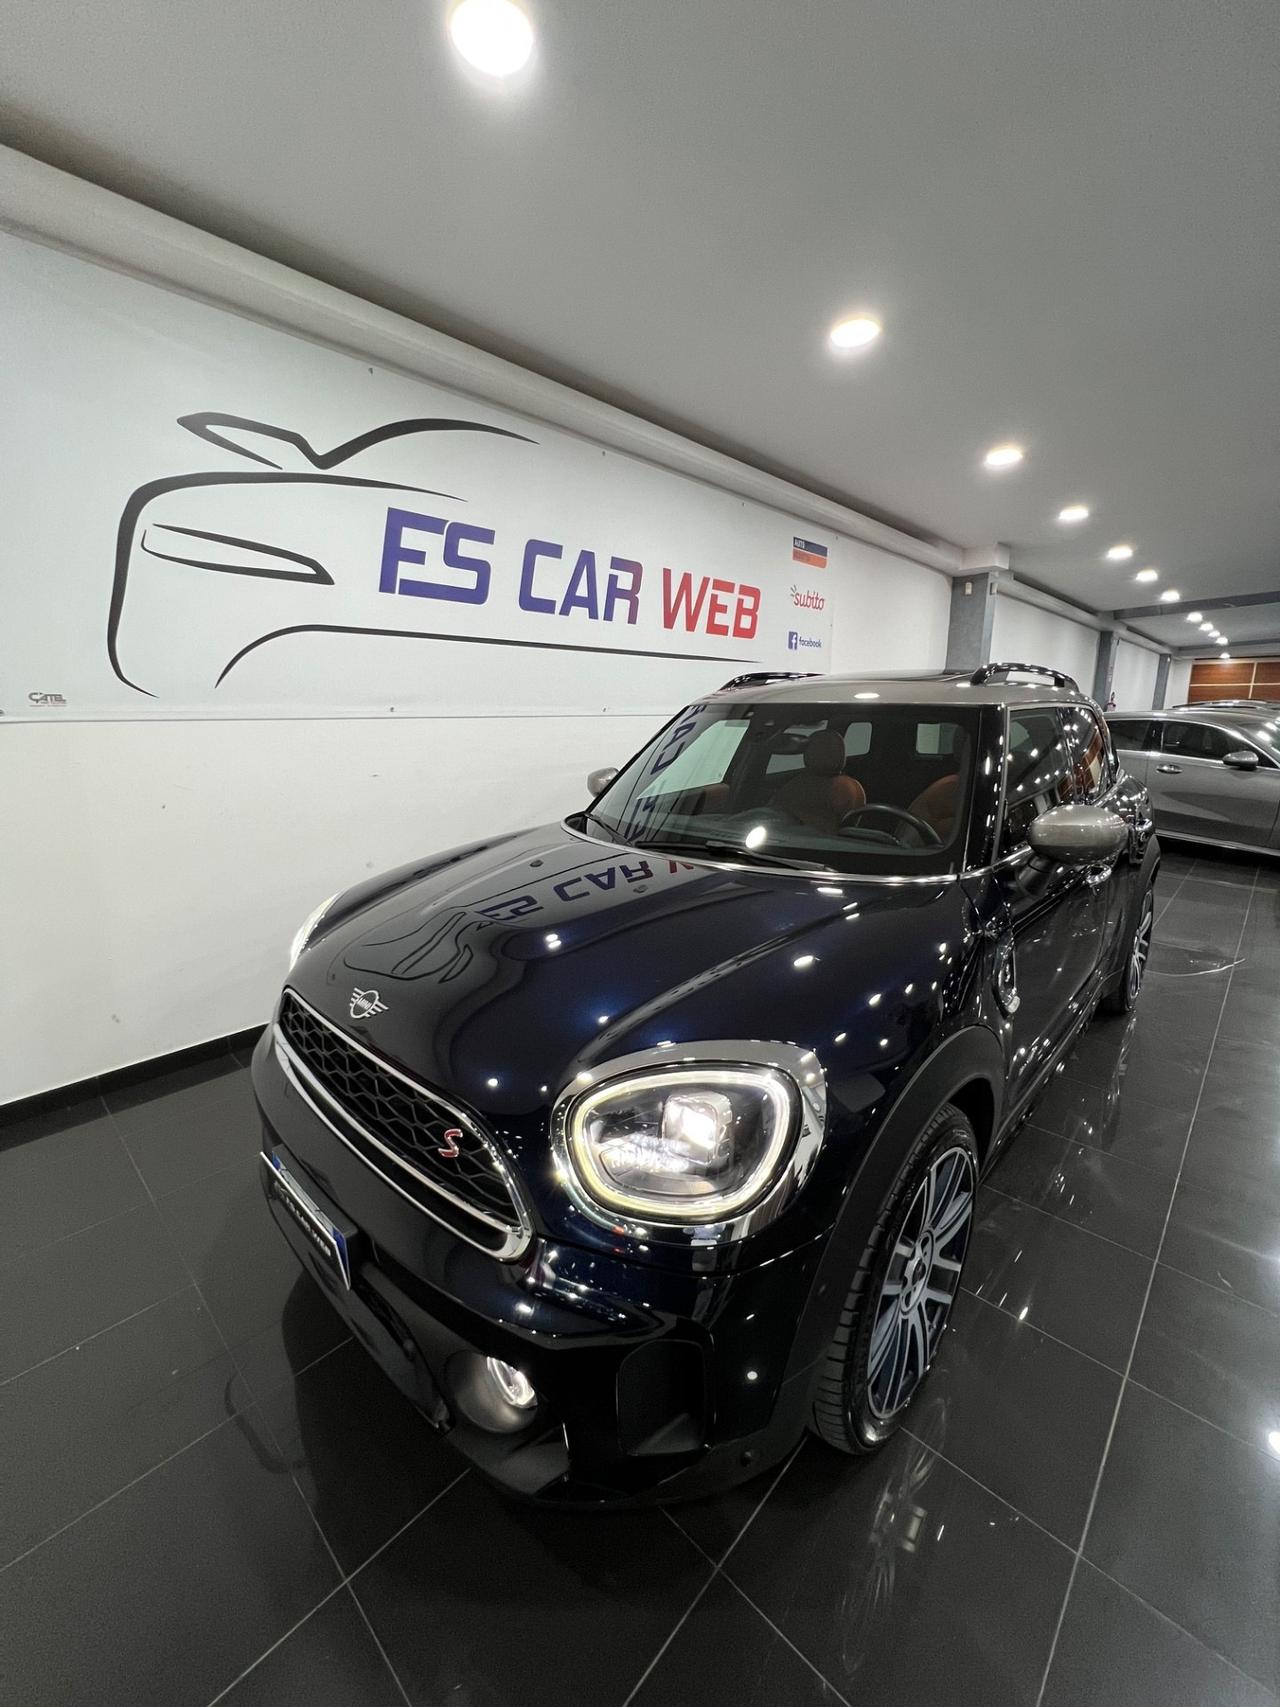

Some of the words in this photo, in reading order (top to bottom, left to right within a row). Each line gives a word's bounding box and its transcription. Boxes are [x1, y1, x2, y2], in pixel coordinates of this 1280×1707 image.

[379, 507, 496, 605] ES
[518, 539, 644, 625] CAR
[662, 568, 761, 640] WEB
[793, 589, 825, 611] subito
[799, 636, 822, 648] facebook
[438, 1128, 463, 1158] S
